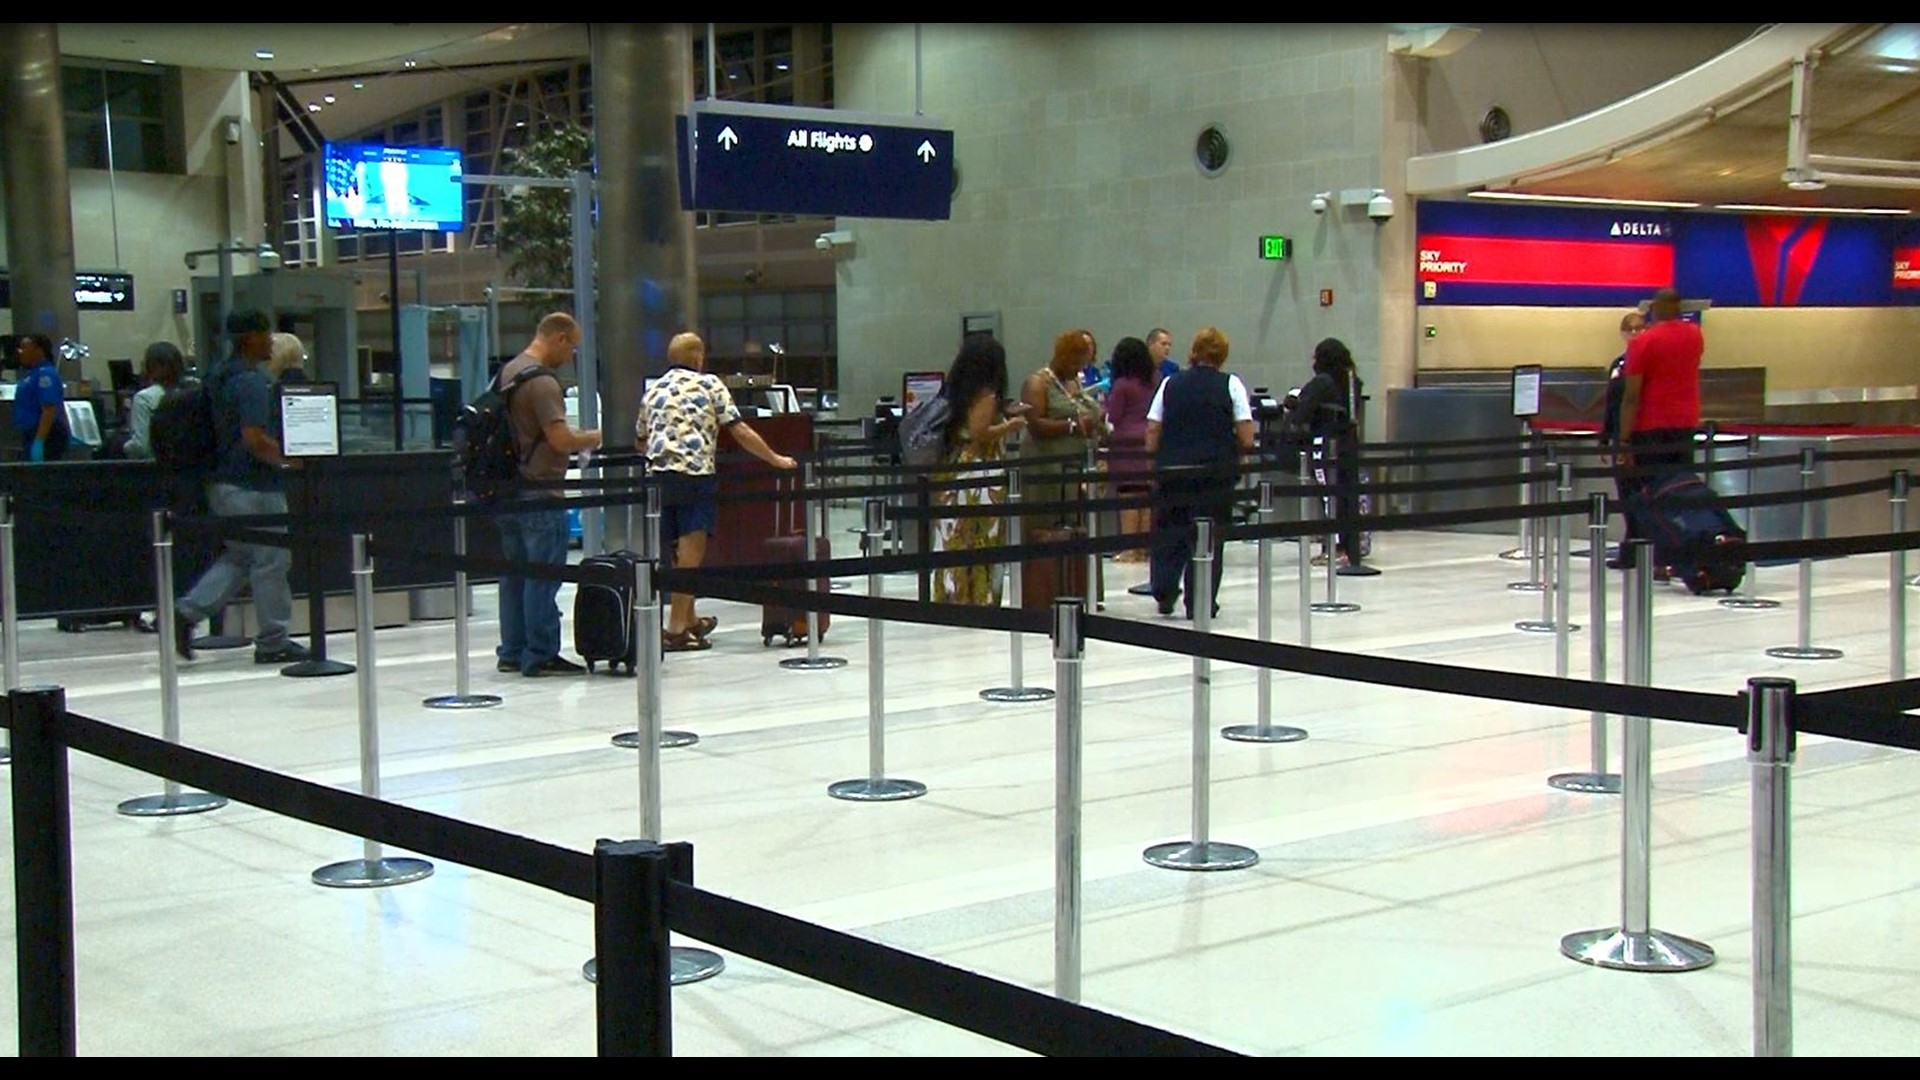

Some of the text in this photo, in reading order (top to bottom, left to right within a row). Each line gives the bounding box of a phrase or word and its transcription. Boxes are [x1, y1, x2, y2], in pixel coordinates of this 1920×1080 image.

[787, 129, 857, 153] All Flights
[1622, 221, 1662, 236] DELTA
[1419, 249, 1441, 261] SKY
[1419, 261, 1468, 273] PRIORITY
